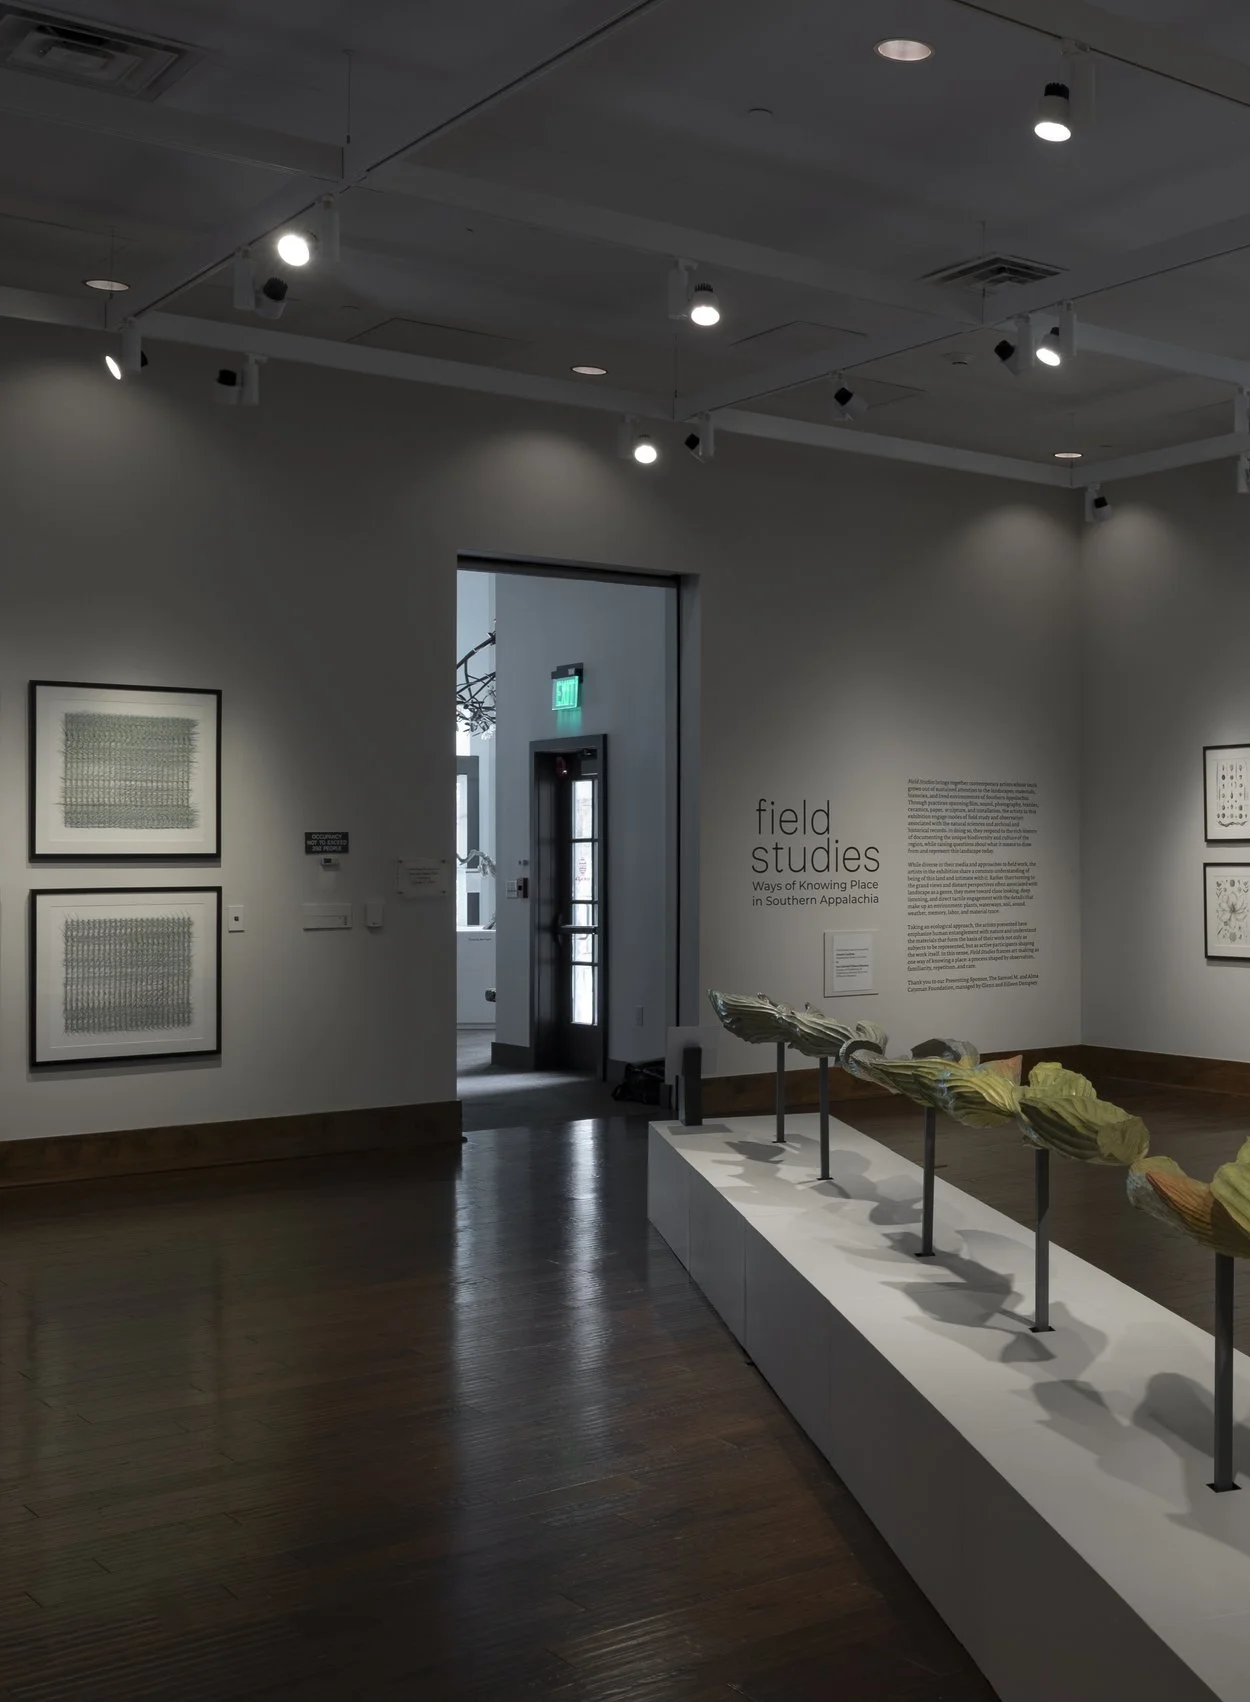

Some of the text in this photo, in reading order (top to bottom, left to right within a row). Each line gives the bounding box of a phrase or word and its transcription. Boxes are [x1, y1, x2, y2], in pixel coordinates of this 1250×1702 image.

[556, 680, 575, 706] EXIT
[756, 799, 830, 835] field
[752, 837, 880, 873] studies
[752, 880, 878, 893] Ways of Knowing Place
[752, 893, 879, 906] in Southern Appalachia
